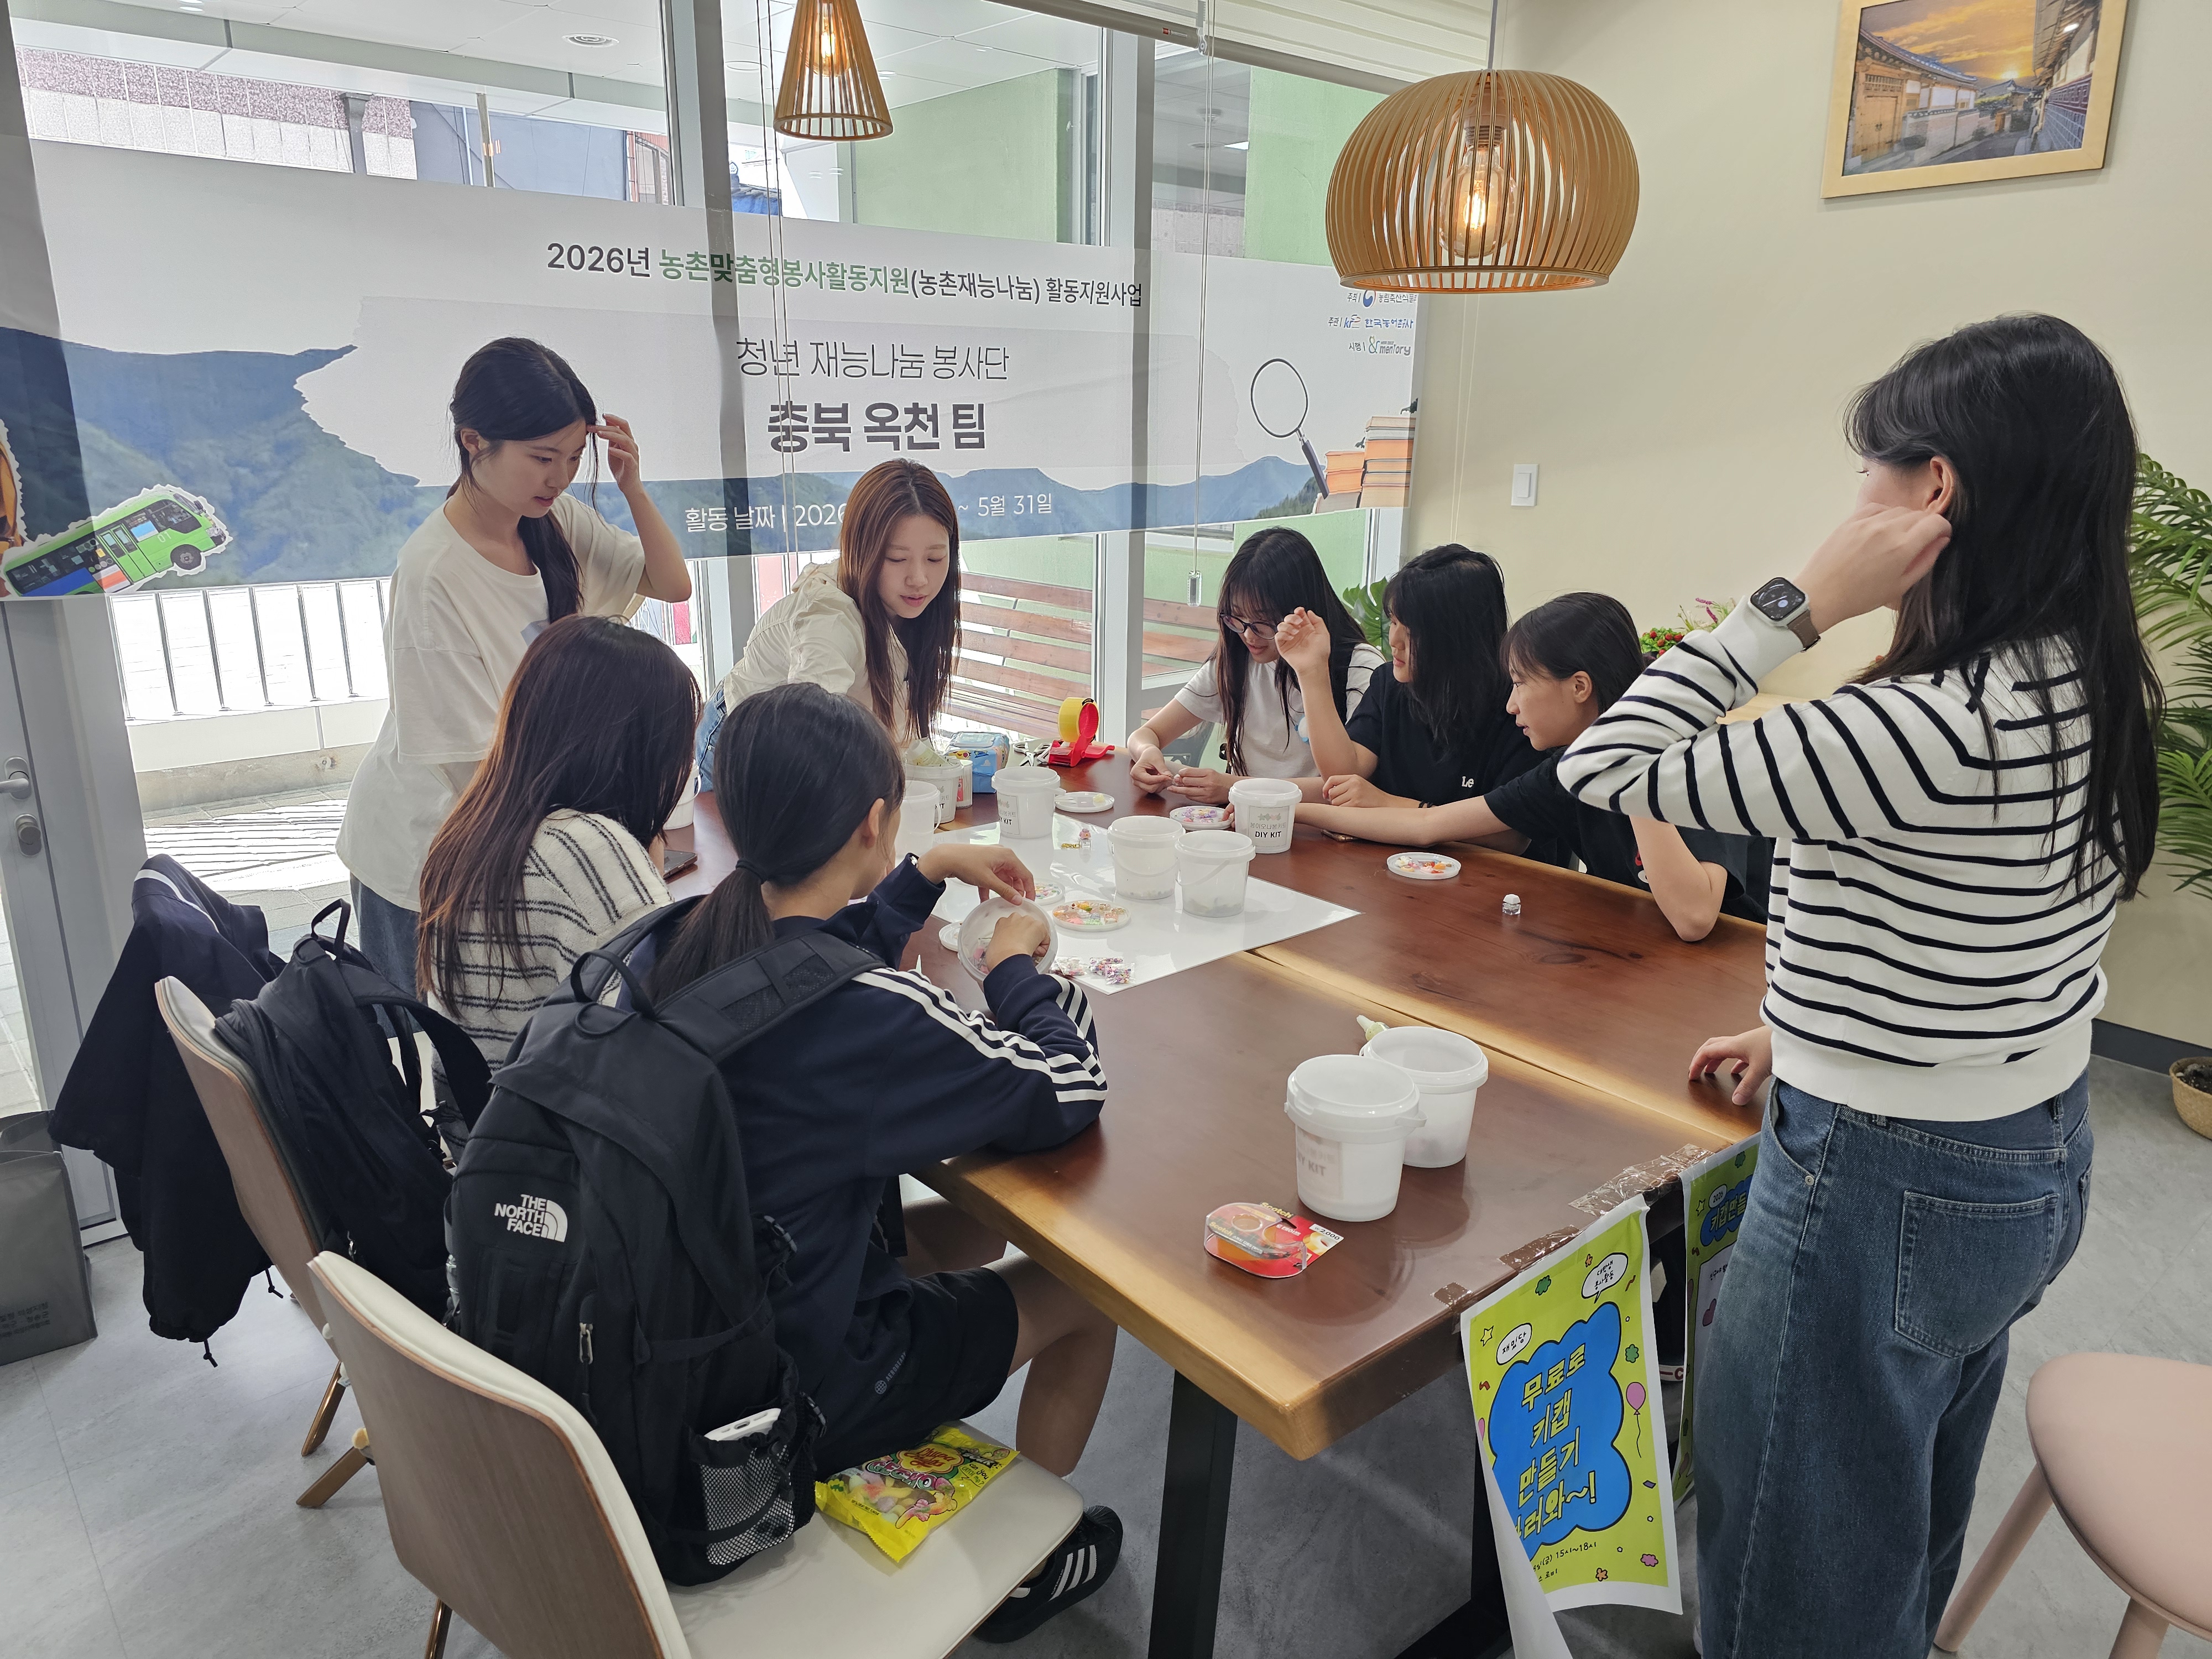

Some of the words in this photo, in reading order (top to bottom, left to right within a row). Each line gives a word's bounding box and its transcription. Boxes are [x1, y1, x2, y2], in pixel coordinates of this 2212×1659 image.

[547, 242, 650, 278] 2026년
[1046, 278, 1142, 307] 활동지원사업
[1328, 317, 1339, 327] 주관
[1349, 342, 1361, 352] 시행
[736, 337, 800, 377] 청년
[810, 341, 926, 379] 재능나눔
[933, 345, 1010, 380] 봉사단
[768, 400, 852, 452] 충북
[863, 402, 941, 451] 옥천
[952, 403, 986, 450] 팀
[685, 507, 728, 533] 활동
[734, 505, 776, 530] 날짜
[978, 495, 1005, 517] 5월
[1013, 493, 1052, 515] 31일
[1308, 1160, 1326, 1176] KIT
[520, 1194, 546, 1212] THE
[1261, 1202, 1293, 1218] Scotch
[1709, 1191, 1747, 1232] 키캡만들
[494, 1203, 545, 1224] NORTH
[507, 1218, 541, 1237] FACE
[1209, 1221, 1234, 1237] Scotch
[1597, 1260, 1613, 1276] 대학생
[885, 1351, 906, 1382] AEROREADY
[1521, 1342, 1586, 1413] 무료로
[1530, 1387, 1573, 1449] 키캡
[917, 1447, 957, 1462] Chupa
[962, 1452, 995, 1466] SOUR
[976, 1469, 989, 1480] you
[1517, 1425, 1580, 1510] 만들기
